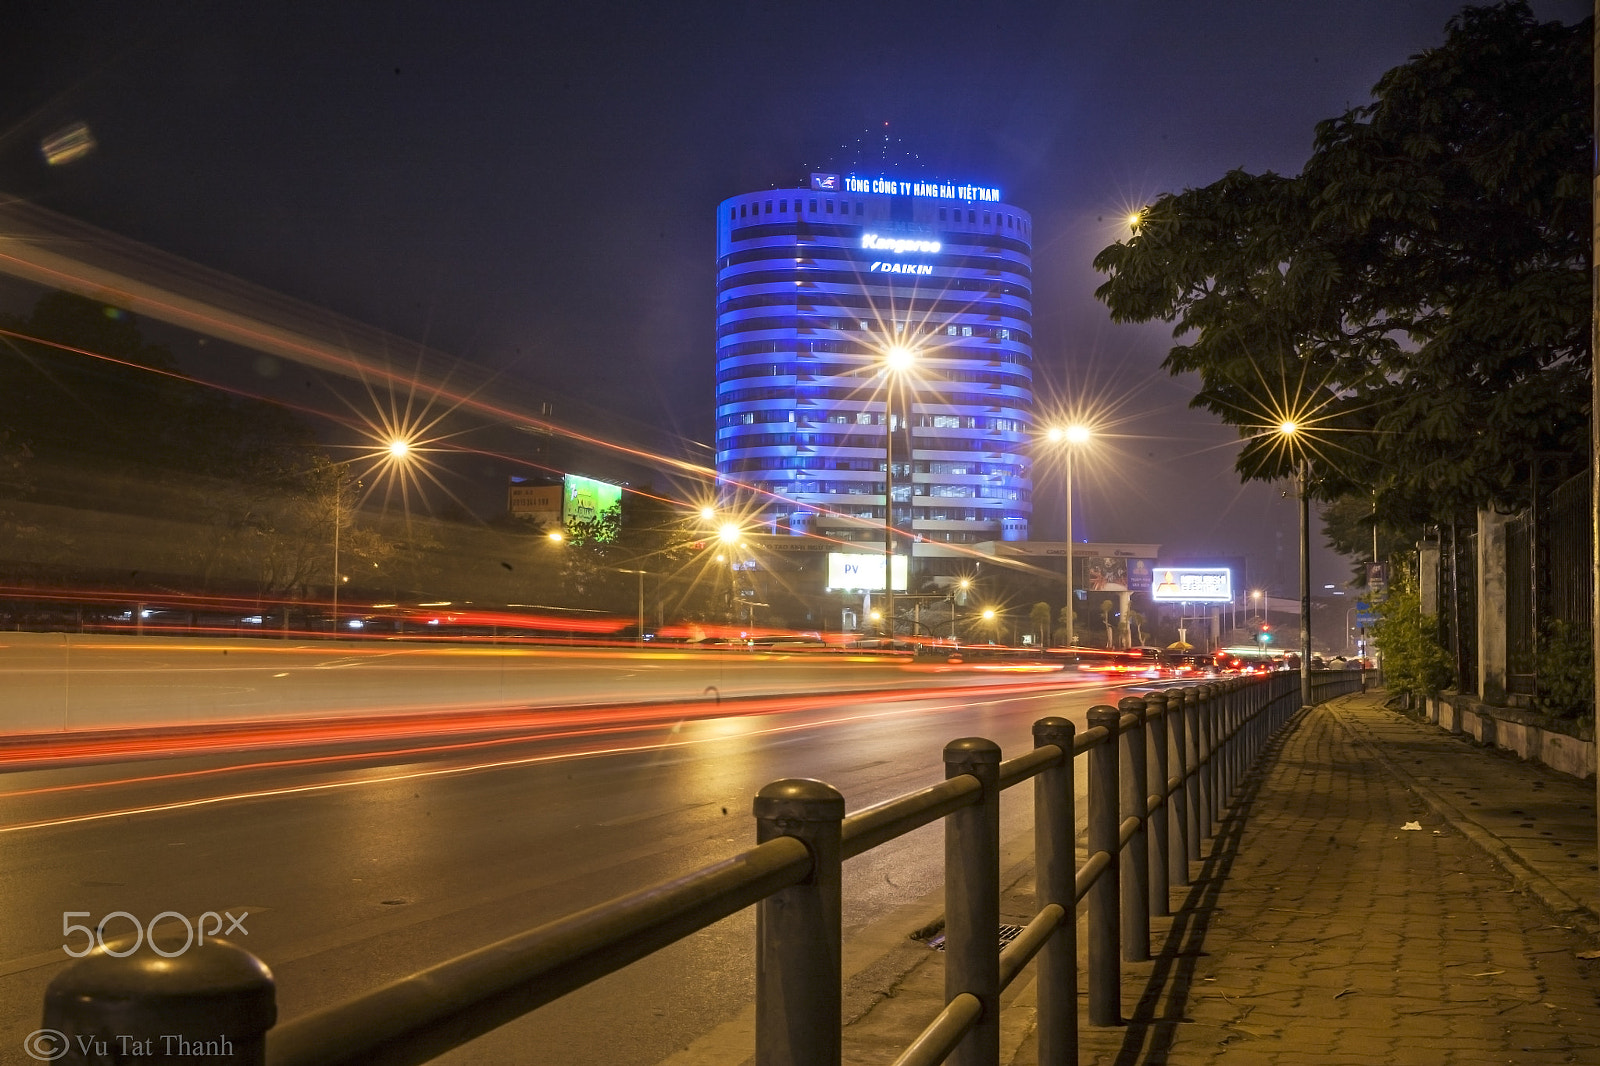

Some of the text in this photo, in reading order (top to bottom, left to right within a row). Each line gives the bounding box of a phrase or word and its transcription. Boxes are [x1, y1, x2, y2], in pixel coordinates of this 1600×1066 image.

[872, 177, 897, 195] CÔNG
[900, 182, 911, 196] TY
[958, 184, 978, 204] VIỆT
[979, 187, 1000, 202] NAM
[881, 262, 933, 275] DAIKIN
[844, 563, 859, 574] PV
